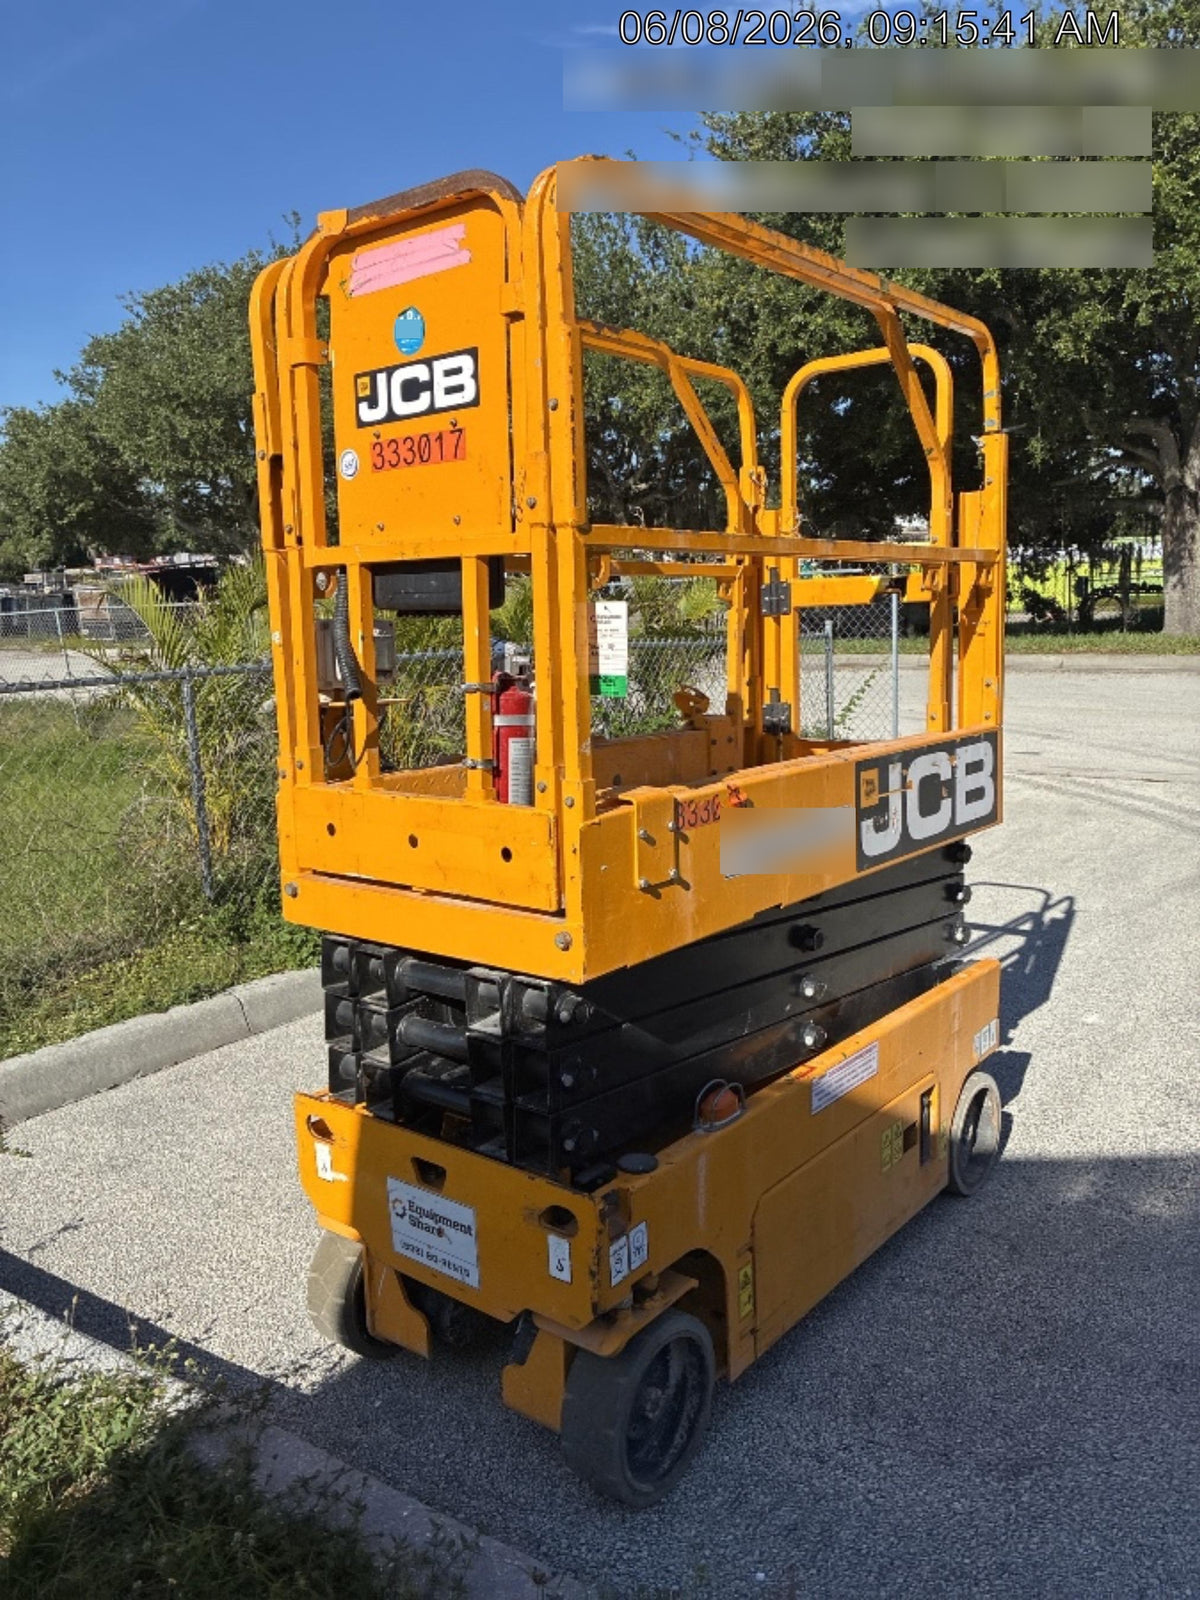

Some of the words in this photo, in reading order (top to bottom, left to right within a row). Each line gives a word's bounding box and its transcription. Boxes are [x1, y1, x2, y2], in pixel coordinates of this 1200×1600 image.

[358, 353, 477, 423] JCB
[372, 428, 464, 471] 333017
[860, 740, 996, 858] JCB
[407, 1199, 474, 1237] Equipment
